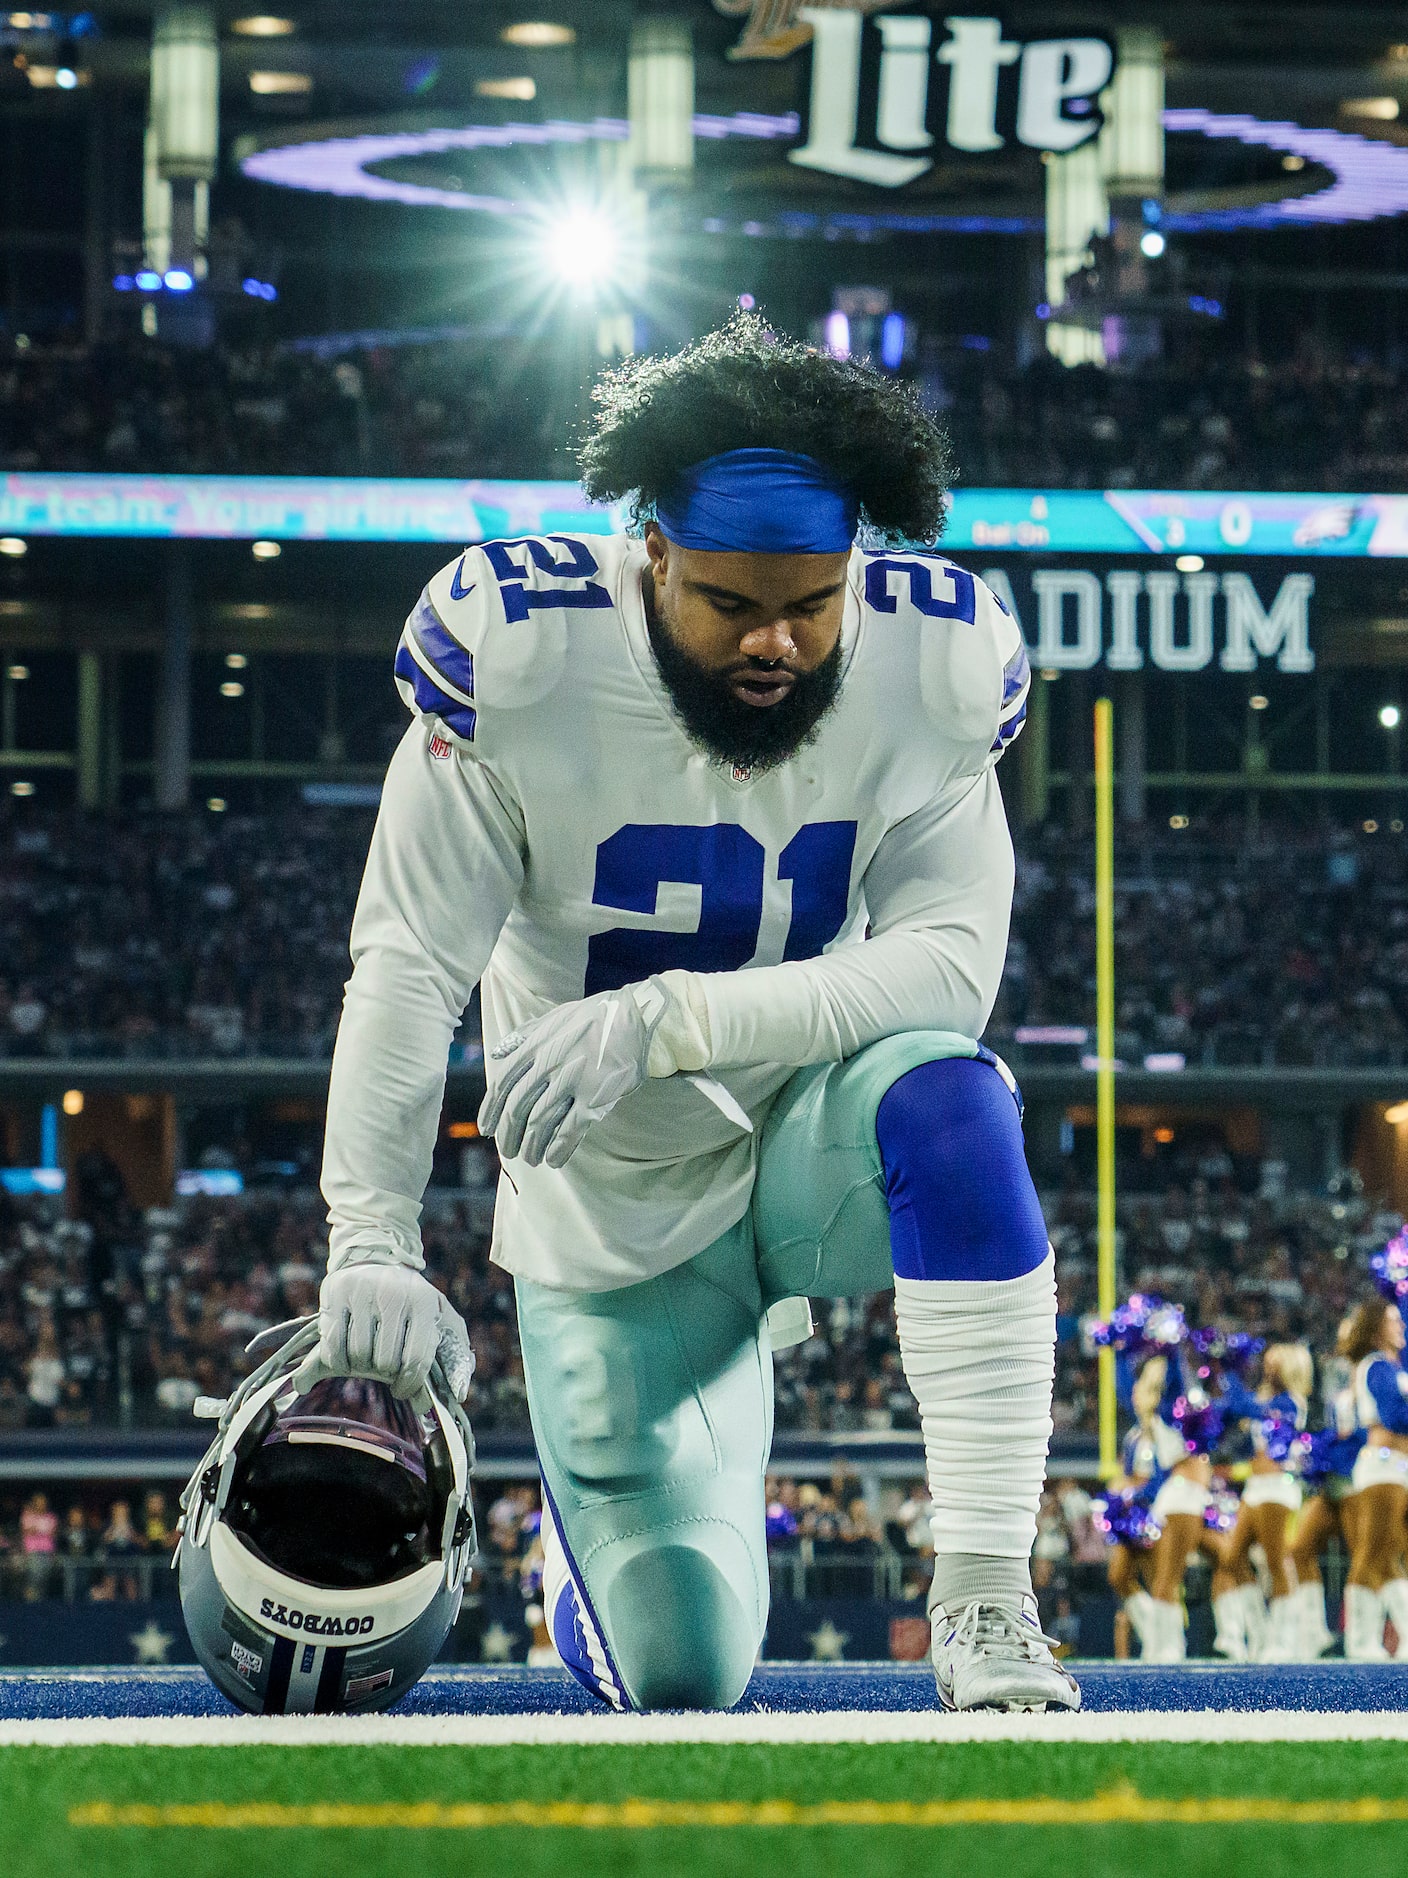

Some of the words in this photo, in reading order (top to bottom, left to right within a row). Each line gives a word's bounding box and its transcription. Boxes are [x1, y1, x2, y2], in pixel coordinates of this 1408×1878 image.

[788, 8, 1112, 187] Lite
[480, 536, 614, 624] 21
[584, 820, 858, 998] 21
[260, 1598, 375, 1635] COWBOYS
